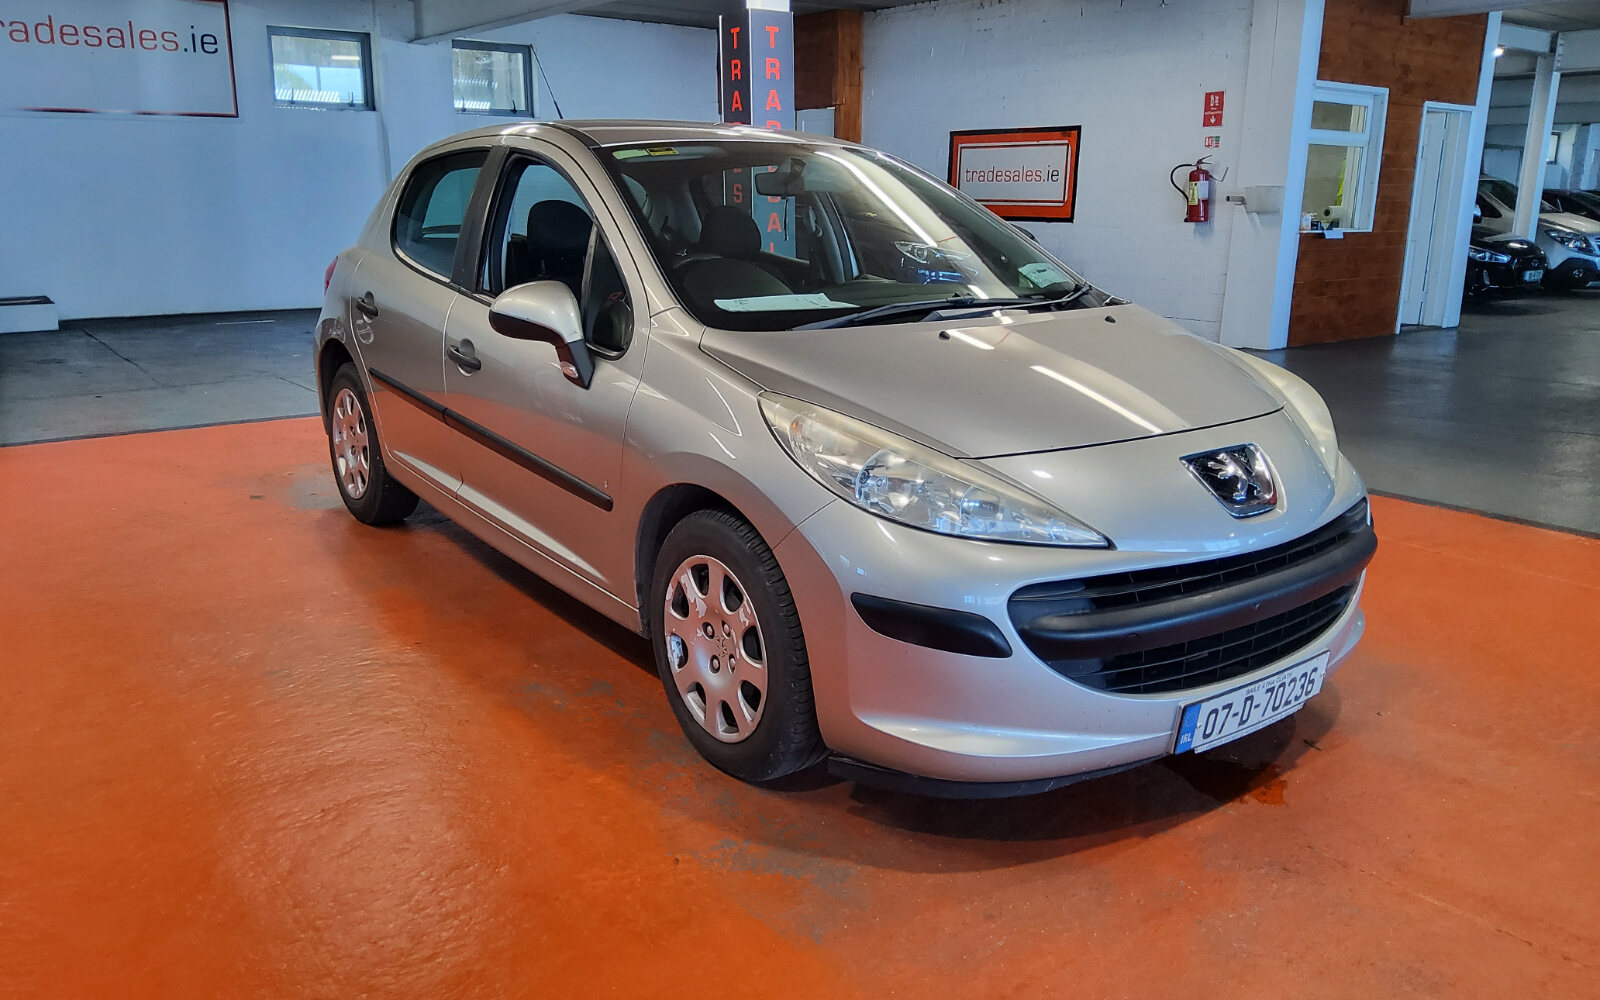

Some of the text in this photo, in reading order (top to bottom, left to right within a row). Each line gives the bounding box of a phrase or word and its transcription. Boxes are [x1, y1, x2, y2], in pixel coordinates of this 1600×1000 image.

[965, 165, 1060, 183] tradesales.ie
[1202, 666, 1319, 739] 07-D-70236
[1180, 731, 1192, 744] IRL
